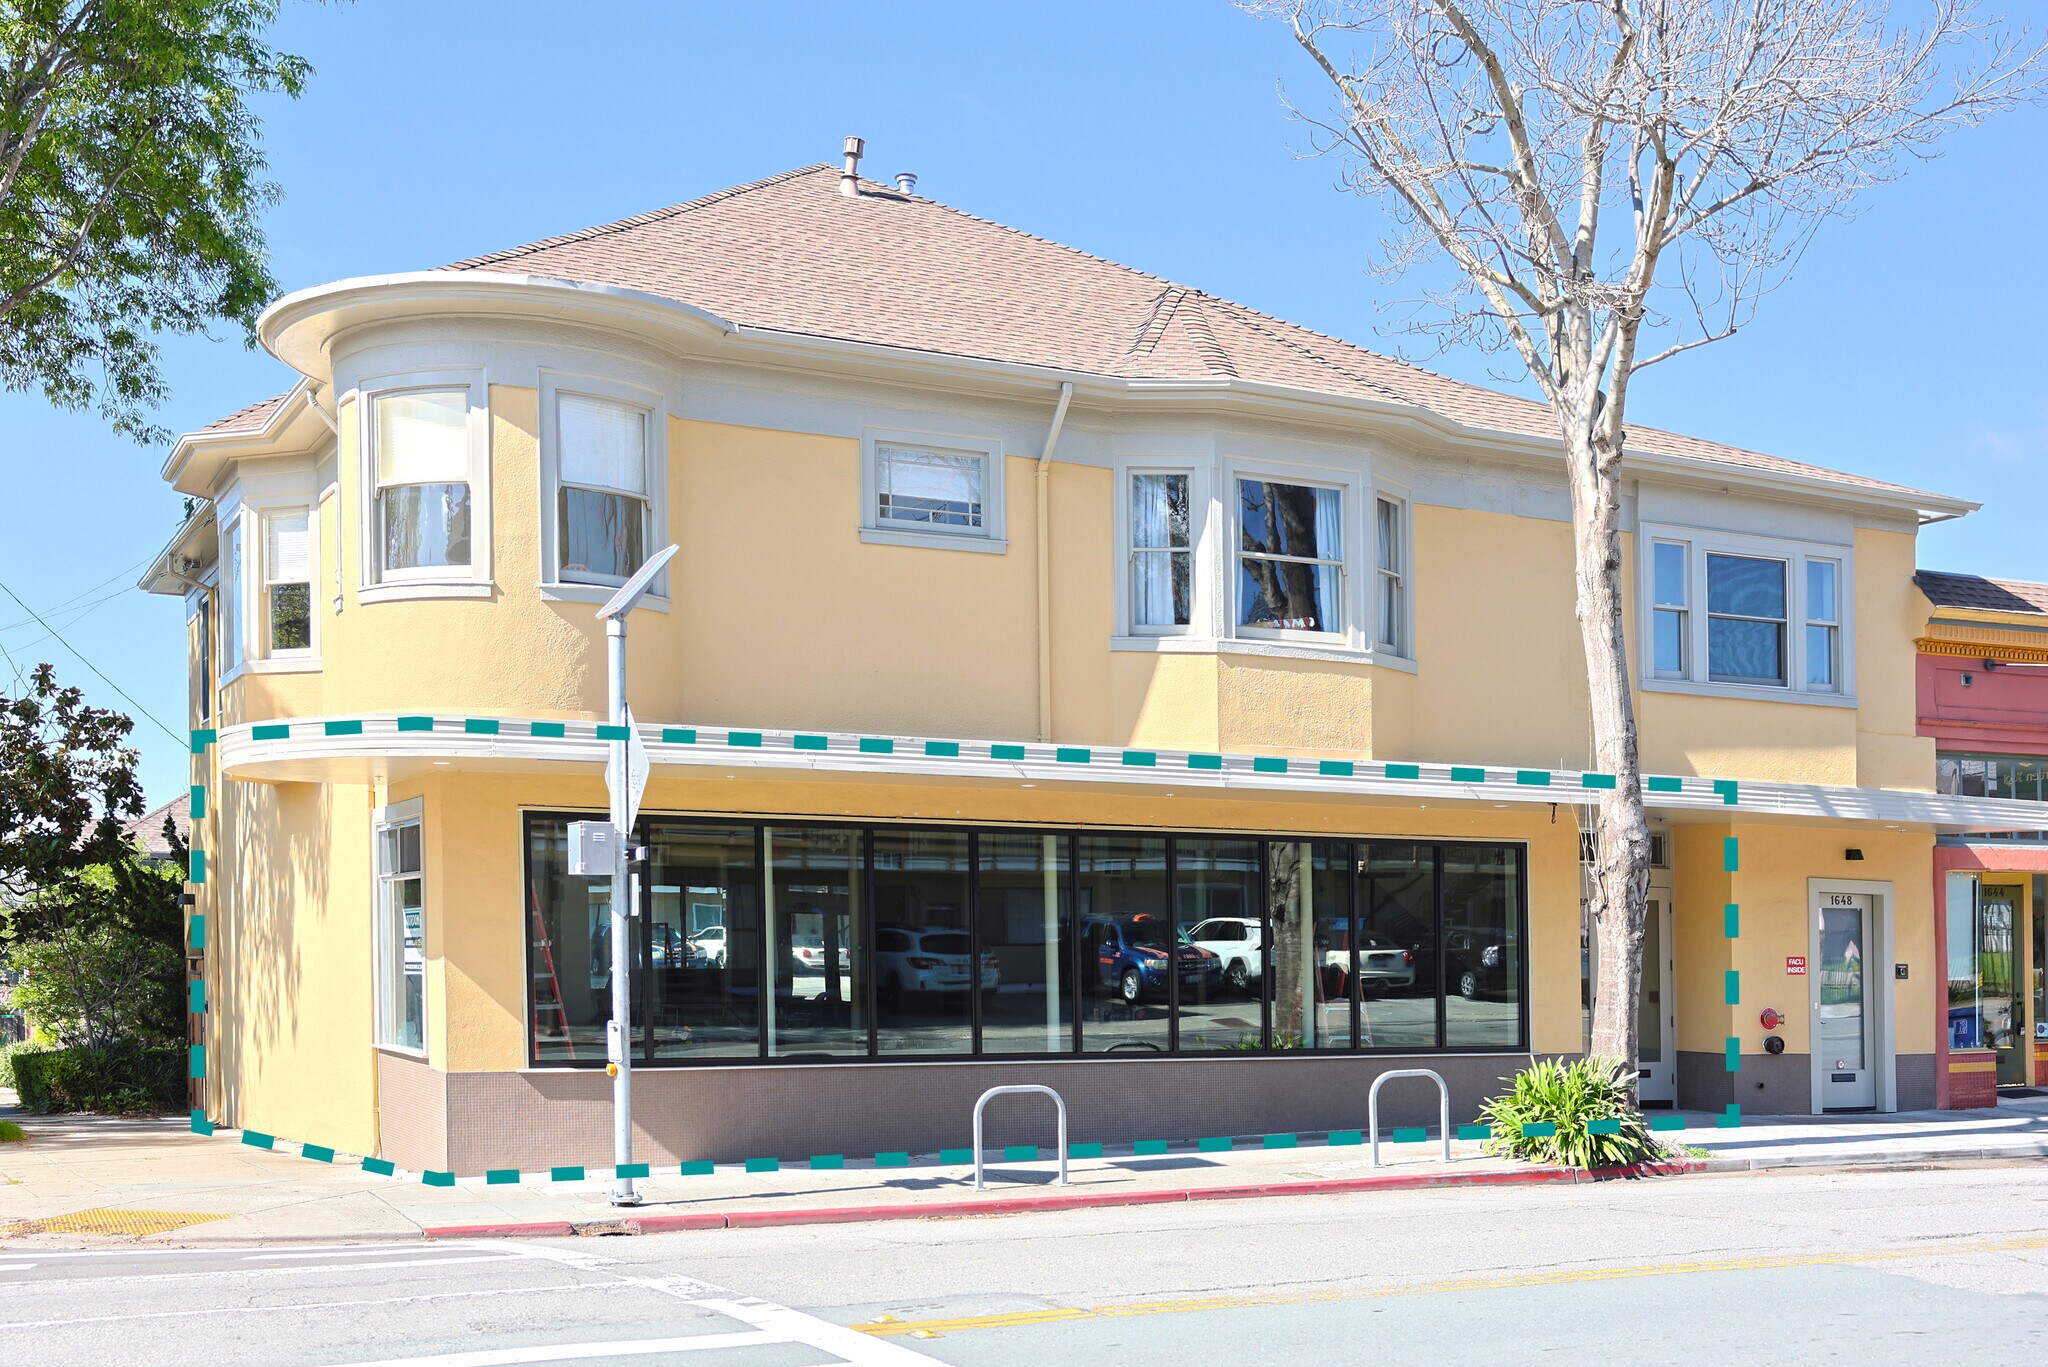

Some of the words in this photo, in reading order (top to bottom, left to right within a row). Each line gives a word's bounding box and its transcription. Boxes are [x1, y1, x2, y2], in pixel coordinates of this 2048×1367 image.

[1984, 887, 2004, 896] 1644
[1830, 895, 1852, 905] 1648
[1787, 966, 1806, 974] INSIDE
